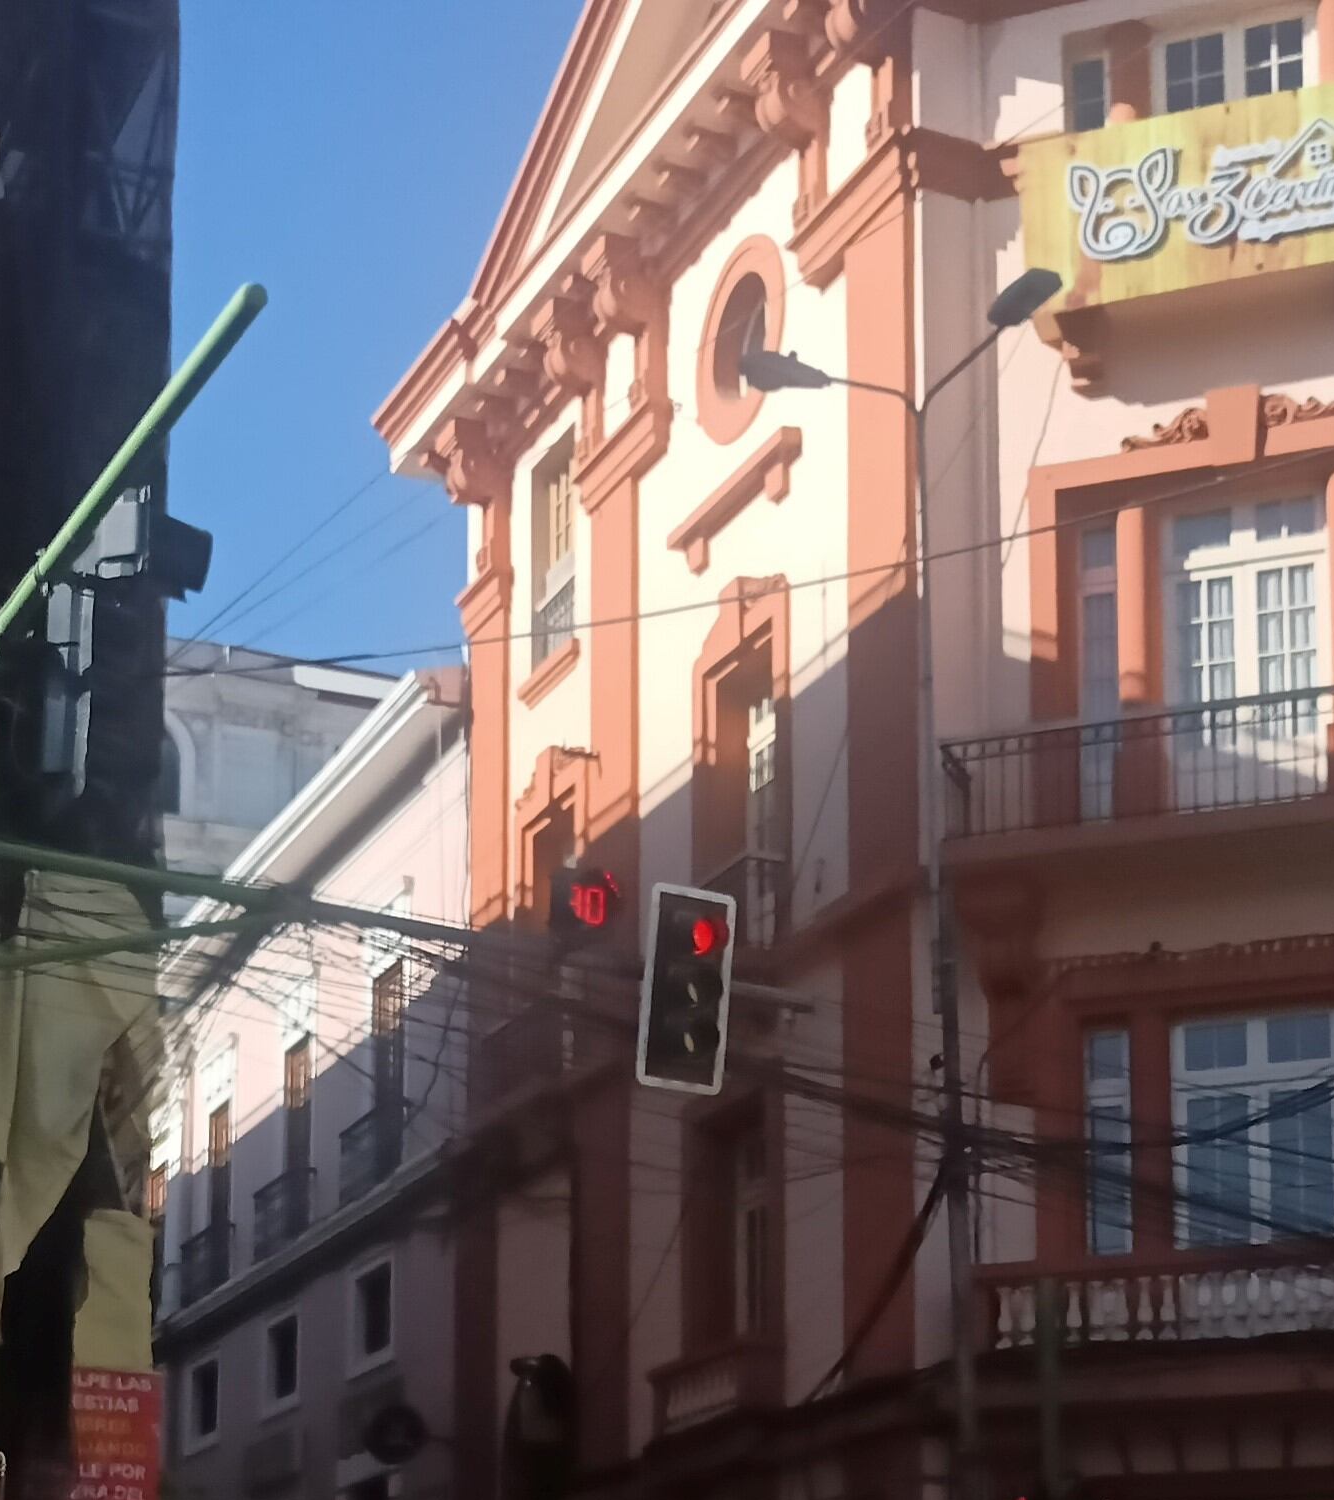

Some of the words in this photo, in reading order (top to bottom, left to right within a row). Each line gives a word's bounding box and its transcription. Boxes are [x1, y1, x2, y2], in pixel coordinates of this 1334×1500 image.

[1186, 166, 1250, 245] 3
[117, 1376, 152, 1393] LAS
[110, 1464, 147, 1480] POR
